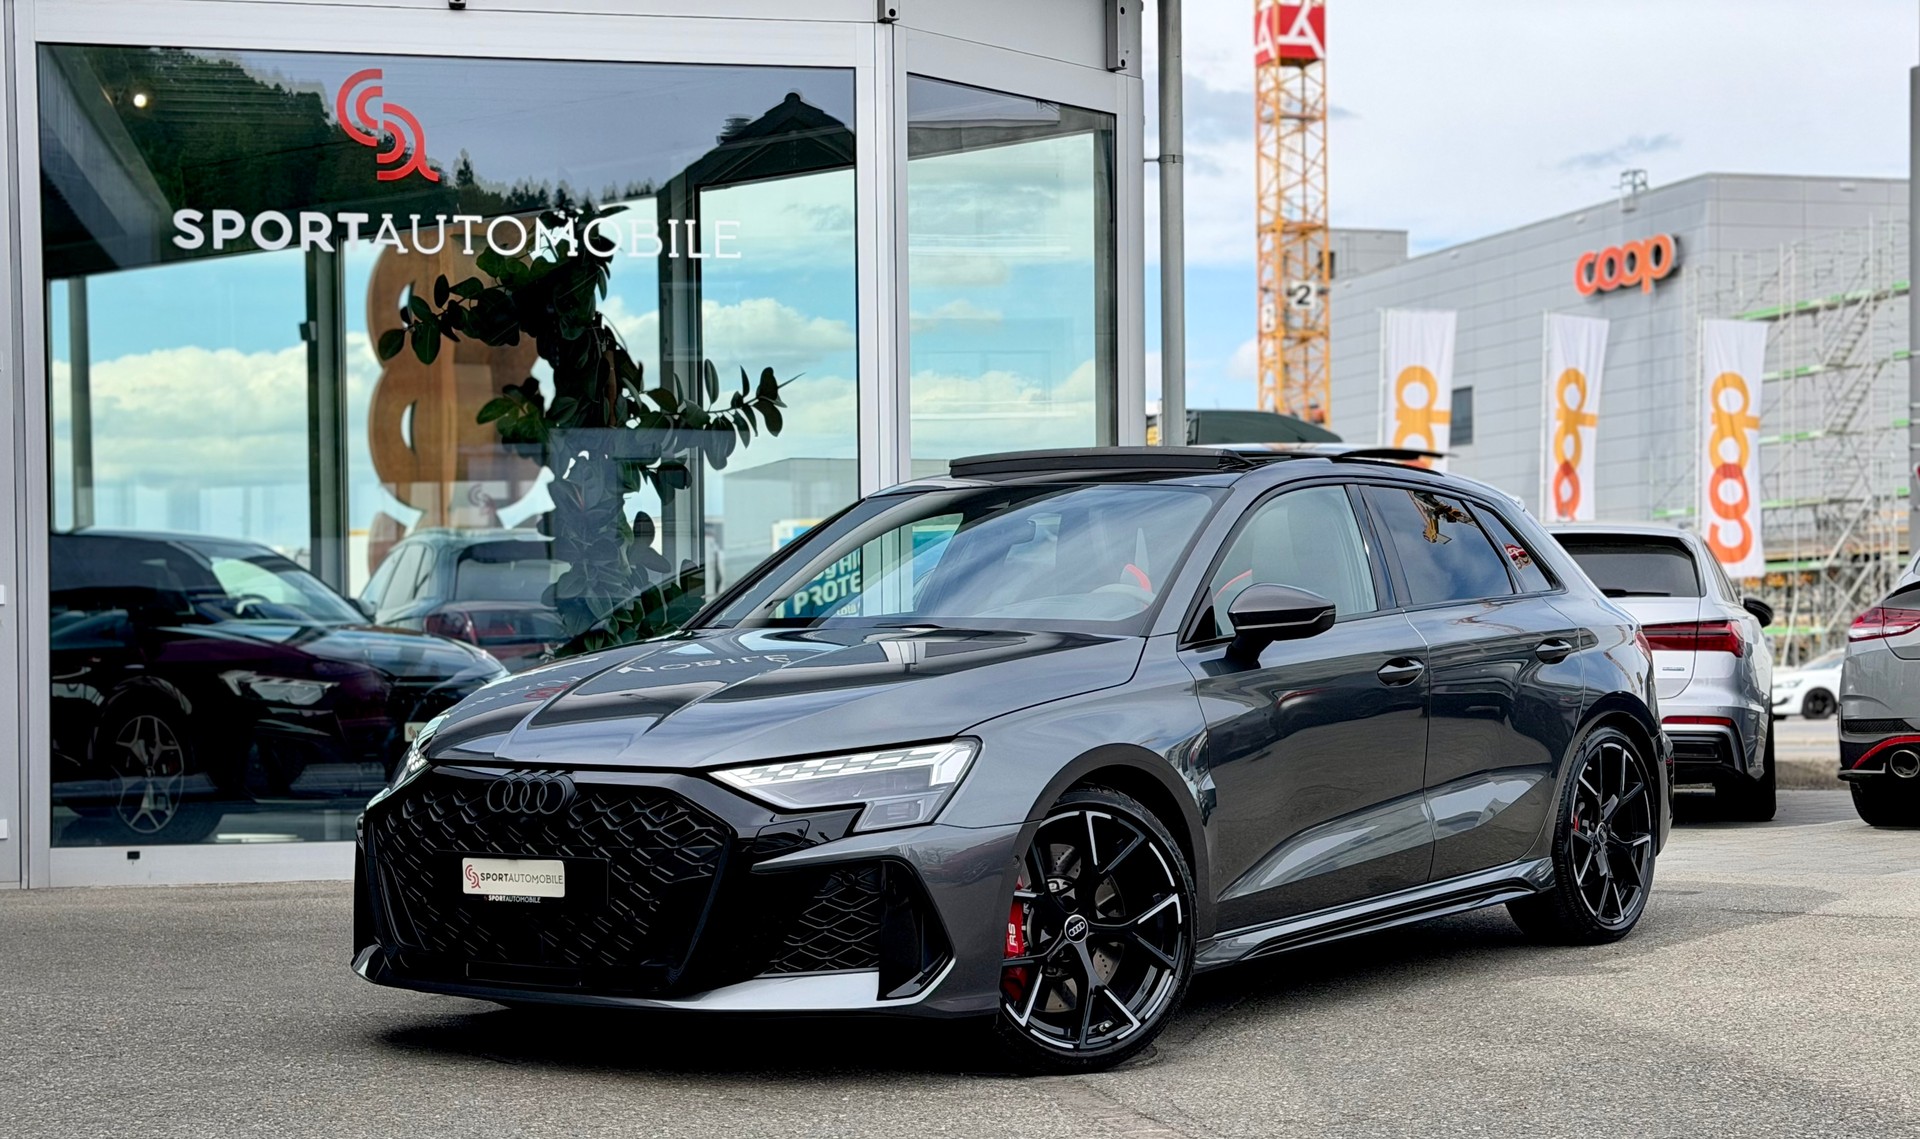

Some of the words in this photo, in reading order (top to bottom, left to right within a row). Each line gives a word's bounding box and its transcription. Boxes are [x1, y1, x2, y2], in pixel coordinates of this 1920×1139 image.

[172, 208, 742, 260] SPORTAUTOMOBILE
[1575, 234, 1673, 296] coop
[1296, 284, 1311, 305] 2
[1552, 367, 1597, 521] oop
[1708, 371, 1760, 563] coop
[480, 873, 563, 884] SPORTAUTOMOBILE
[488, 895, 540, 903] SPORTAUTOMOBILE
[1008, 923, 1017, 946] RS
